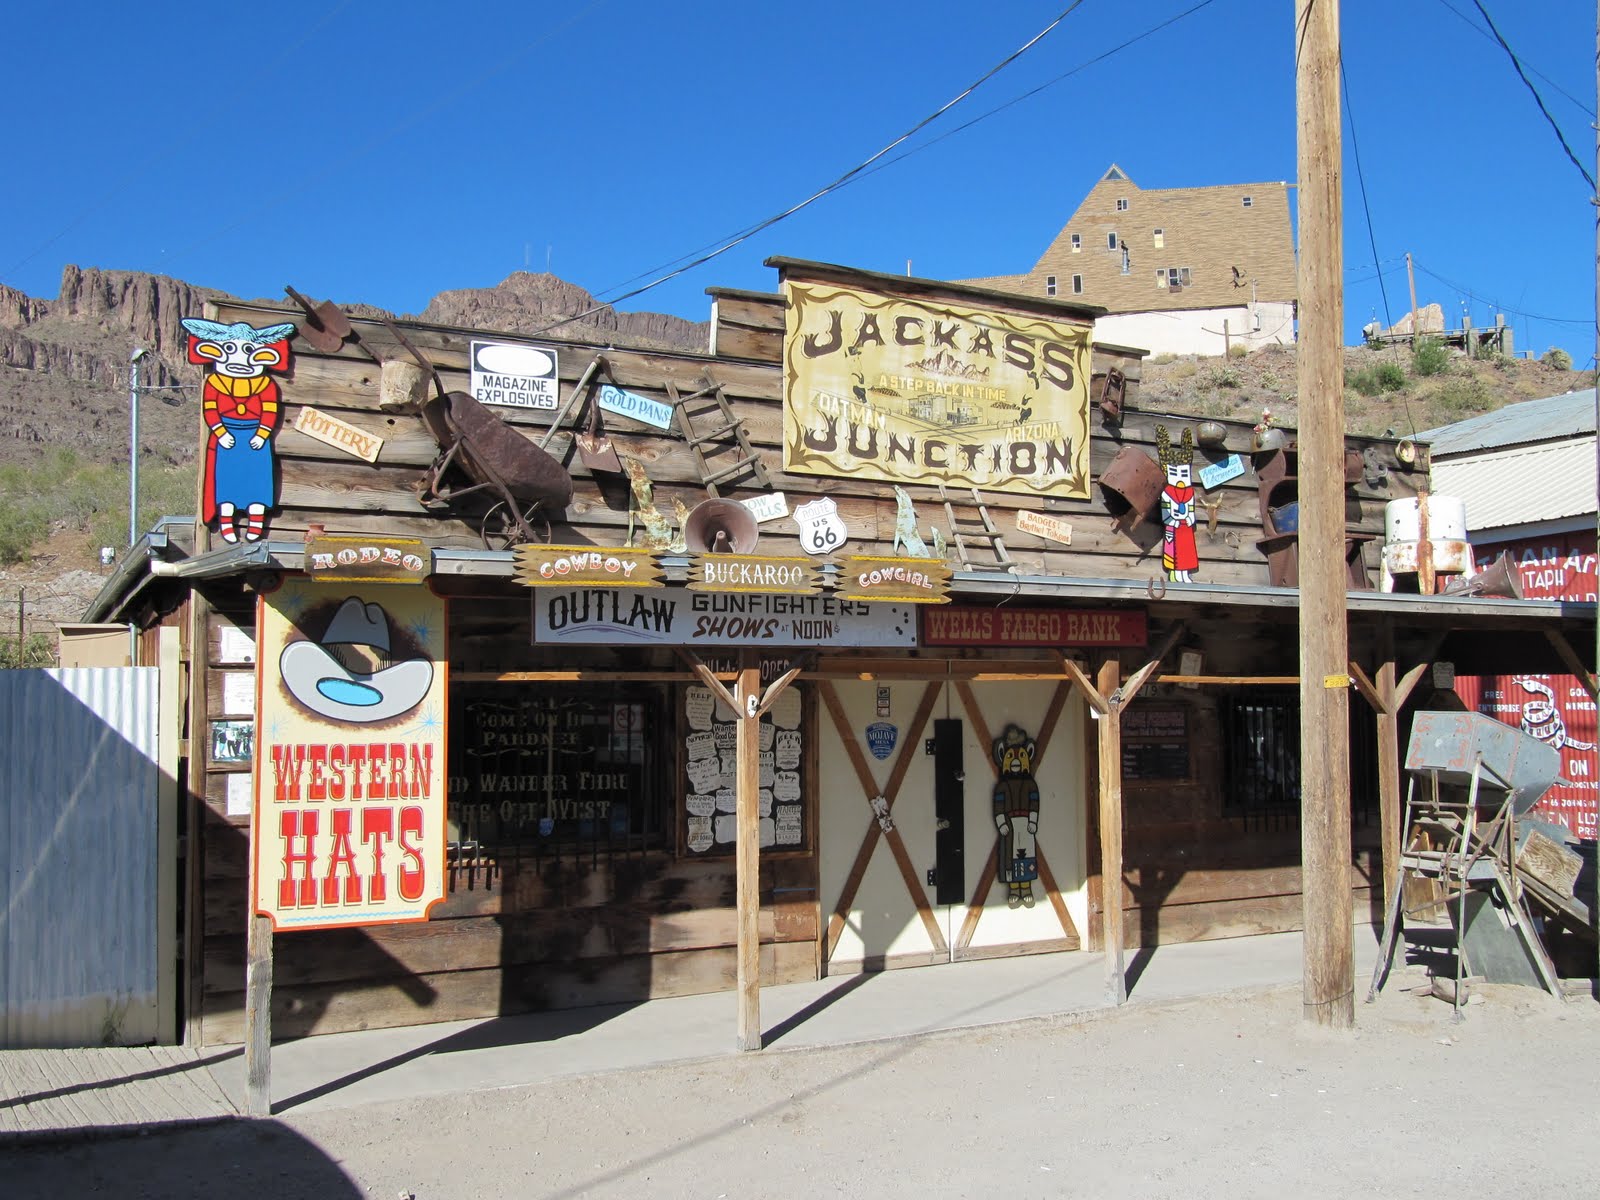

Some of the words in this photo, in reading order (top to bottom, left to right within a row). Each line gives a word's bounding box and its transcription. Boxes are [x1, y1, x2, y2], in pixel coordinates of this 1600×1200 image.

[801, 309, 1076, 392] JACKASS
[482, 374, 548, 392] MAGAZINE
[879, 375, 888, 387] A
[890, 376, 924, 391] STEP
[926, 378, 960, 396] BACK
[962, 382, 974, 397] IN
[976, 383, 1008, 401] TIME
[476, 388, 554, 408] EXPLOSIVES
[603, 390, 637, 411] GOLD
[638, 401, 670, 422] PANS
[818, 394, 886, 429] OATMAN
[1004, 422, 1060, 442] ARIZONA
[300, 410, 377, 457] POTTERY
[803, 414, 1073, 476] JUNCTION
[747, 497, 766, 510] OW
[803, 503, 829, 518] ROUTE
[812, 518, 828, 527] US
[813, 527, 837, 549] 66
[312, 546, 424, 571] RODEO
[540, 552, 637, 578] COWBOY
[704, 562, 803, 586] BUCKAROO
[858, 567, 933, 589] COWGIRL
[548, 589, 676, 632] OUTLAW
[691, 594, 870, 616] GUNFIGHTERS
[692, 615, 779, 638] SHOWS
[792, 620, 833, 640] NOON
[929, 611, 993, 639] WELLS
[1001, 612, 1061, 640] FARGO
[1067, 614, 1121, 641] BANK
[1484, 690, 1504, 699] FREE
[1569, 687, 1588, 697] GOL
[1478, 703, 1521, 713] ENTERPRISE
[869, 730, 895, 741] MOJAVE
[270, 743, 434, 803] WESTERN
[1570, 759, 1588, 776] ON
[1577, 811, 1598, 826] LLO
[277, 806, 427, 909] HATS
